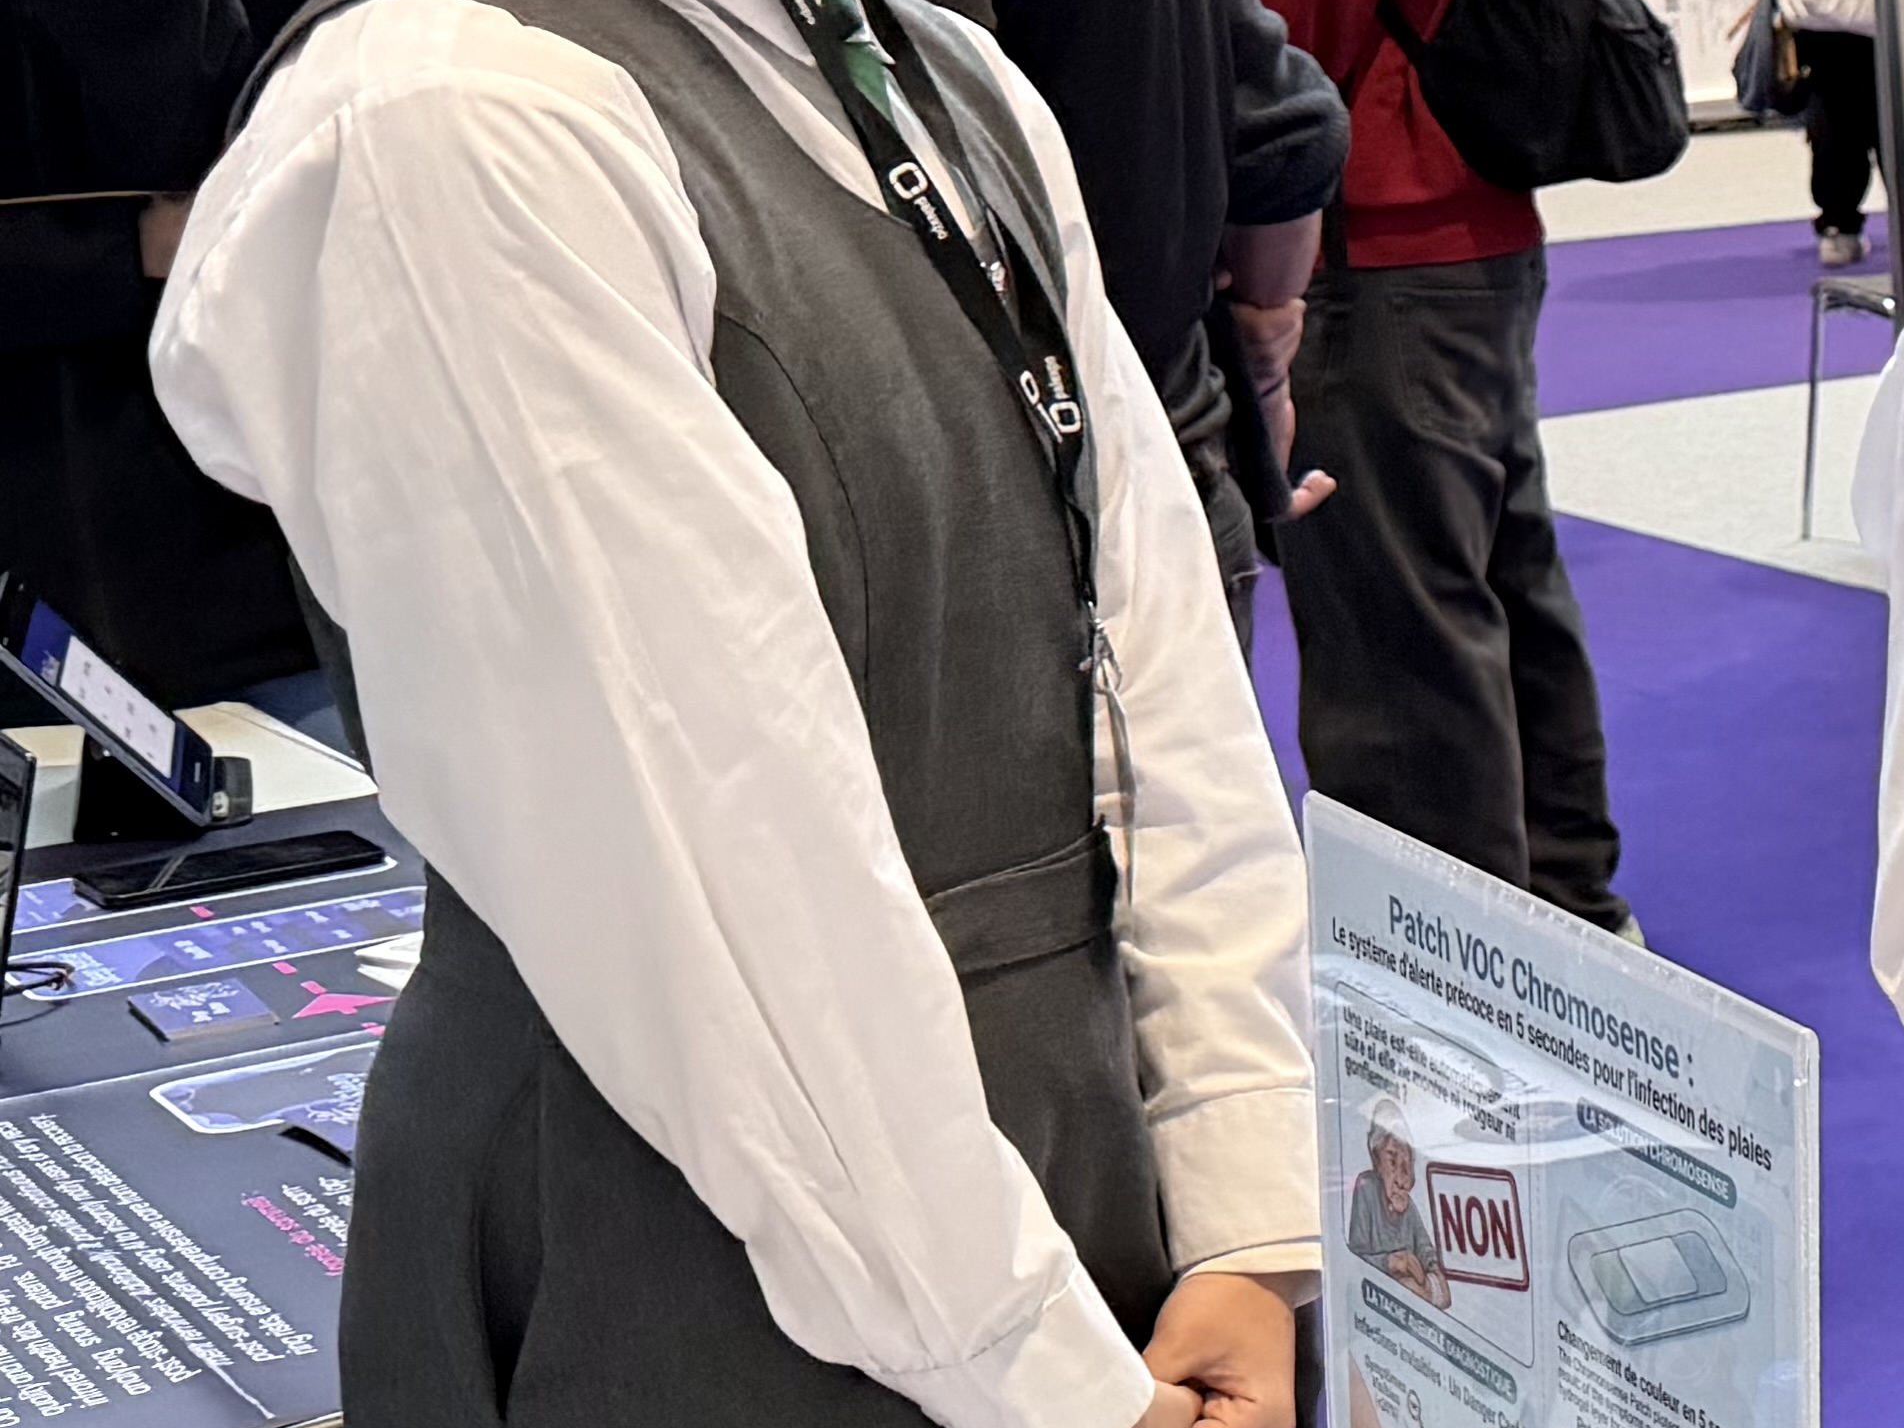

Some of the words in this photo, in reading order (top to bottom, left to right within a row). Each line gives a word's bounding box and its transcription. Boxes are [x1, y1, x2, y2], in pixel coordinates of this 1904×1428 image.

[1389, 895, 1450, 963] Patch
[1455, 927, 1505, 989] VOC
[1512, 956, 1680, 1080] Chromosense
[1332, 916, 1347, 946] Le
[1348, 926, 1397, 974] système
[1399, 943, 1444, 998] d'alerte
[1445, 974, 1495, 1025] précoce
[1497, 1007, 1514, 1035] en
[1515, 1011, 1525, 1039] 5
[1527, 1016, 1591, 1074] secondes
[1593, 1056, 1624, 1092] pour
[1627, 1064, 1696, 1129] l'infection
[1698, 1105, 1725, 1146] des
[1728, 1125, 1773, 1172] plaies
[61, 1143, 84, 1155] to
[70, 1151, 122, 1186] detection
[108, 1183, 143, 1205] from
[128, 1201, 163, 1221] care
[0, 1212, 49, 1250] targeted
[1439, 1193, 1517, 1261] NON
[32, 1245, 83, 1281] through
[134, 1247, 173, 1272] using
[149, 1219, 229, 1279] comprehensive
[69, 1275, 139, 1333] rehabilitation
[215, 1276, 270, 1315] ensuring
[53, 1309, 101, 1347] snoring
[199, 1306, 284, 1361] post-surgery
[280, 1333, 317, 1355] ring
[25, 1338, 71, 1371] health
[91, 1347, 150, 1395] analyzing
[126, 1329, 201, 1382] post-stage
[1558, 1320, 1622, 1379] Changement
[1624, 1359, 1638, 1388] de
[1639, 1376, 1681, 1417] couleur
[1682, 1400, 1697, 1425] en
[17, 1381, 71, 1416] quality
[49, 1367, 108, 1408] infrared
